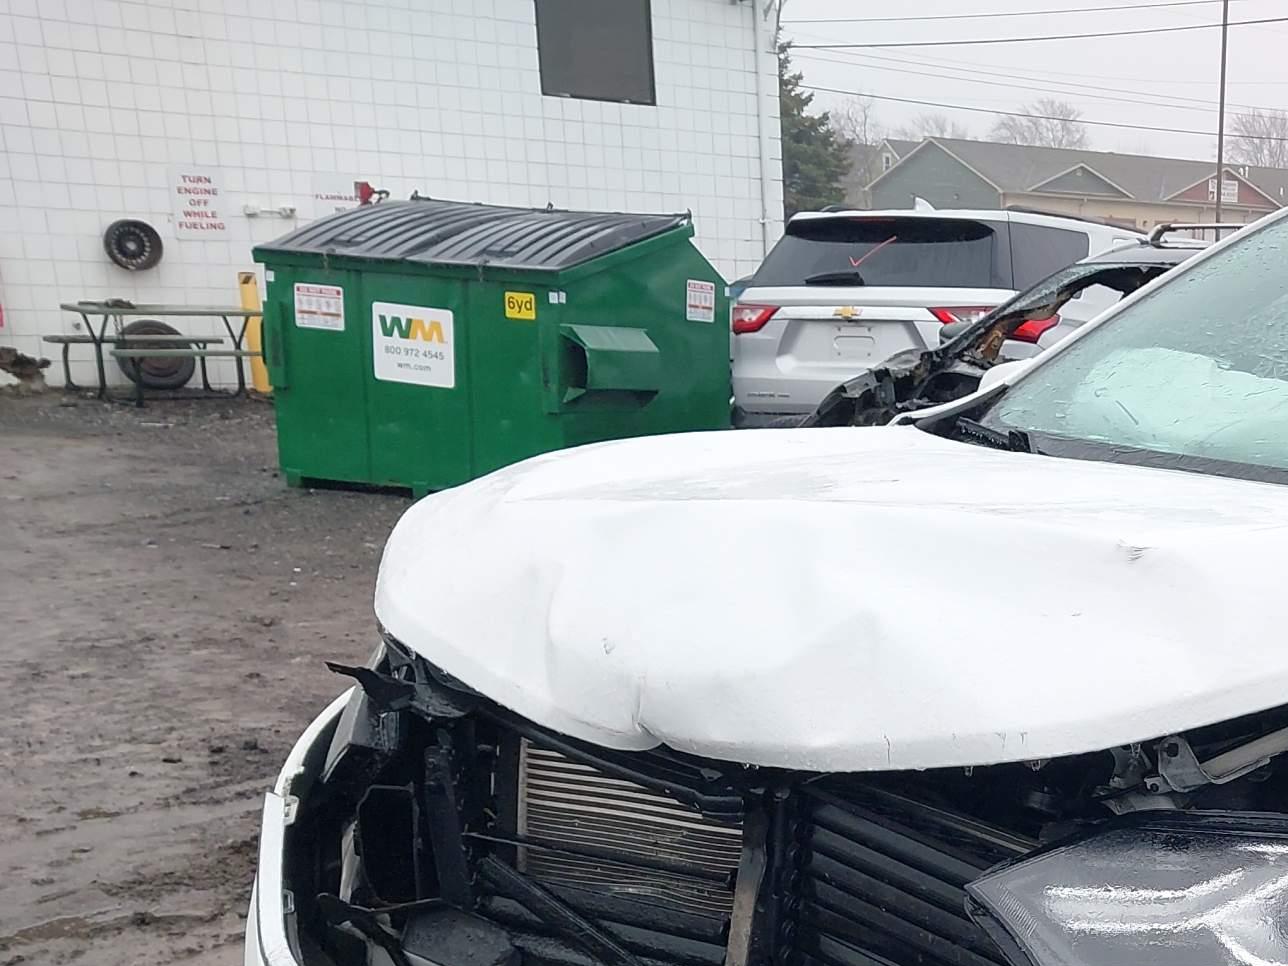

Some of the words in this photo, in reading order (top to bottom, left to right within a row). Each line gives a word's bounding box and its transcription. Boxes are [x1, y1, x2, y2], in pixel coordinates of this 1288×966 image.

[181, 174, 211, 184] TURN
[176, 186, 218, 196] ENGINE
[183, 210, 217, 218] WHILE
[178, 221, 225, 230] FUELING
[507, 295, 533, 314] 6yd
[378, 314, 445, 344] WM
[384, 345, 401, 355] 800
[403, 347, 420, 358] 972
[422, 349, 445, 360] 4545
[397, 362, 431, 372] wm.com
